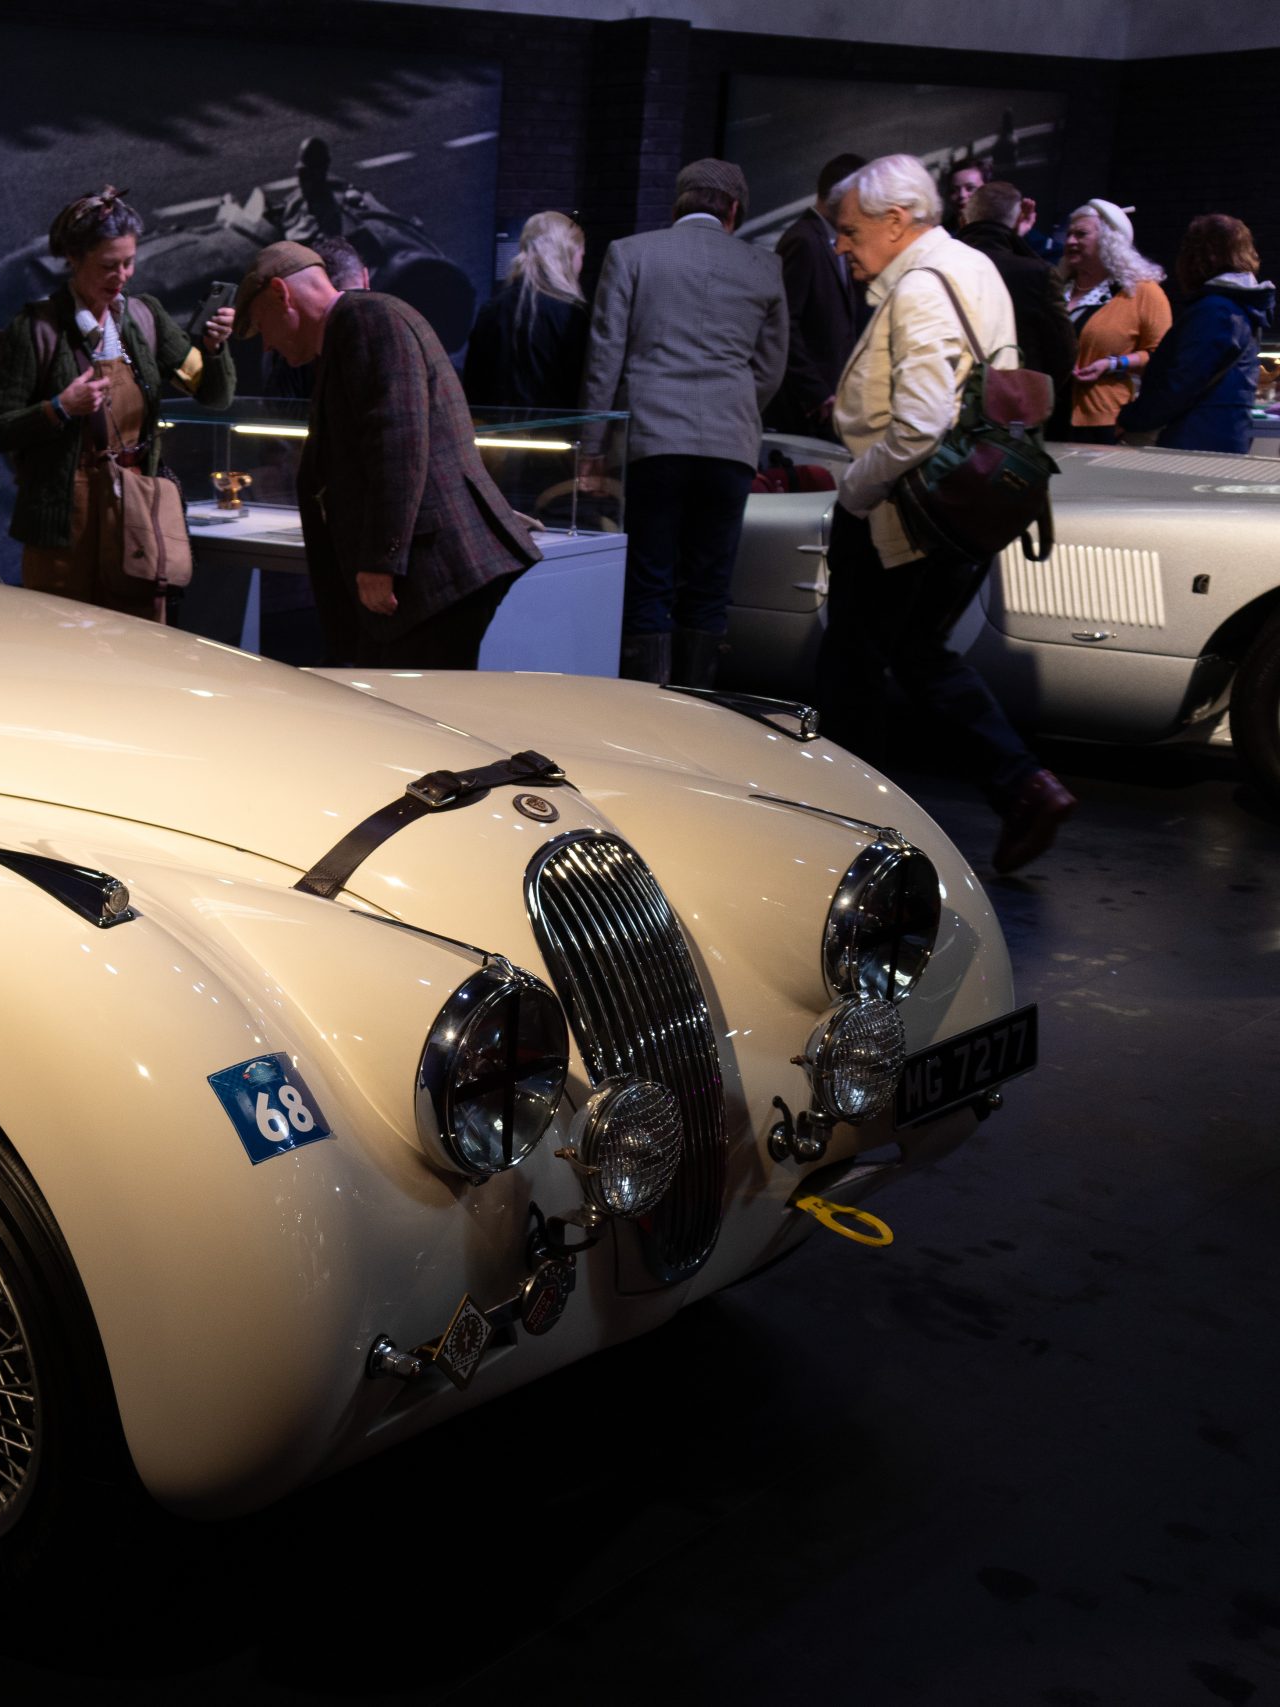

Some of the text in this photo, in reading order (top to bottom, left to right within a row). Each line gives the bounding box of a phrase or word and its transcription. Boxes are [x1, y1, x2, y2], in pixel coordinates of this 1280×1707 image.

[904, 1018, 1029, 1115] MG 7277
[255, 1084, 314, 1142] 68
